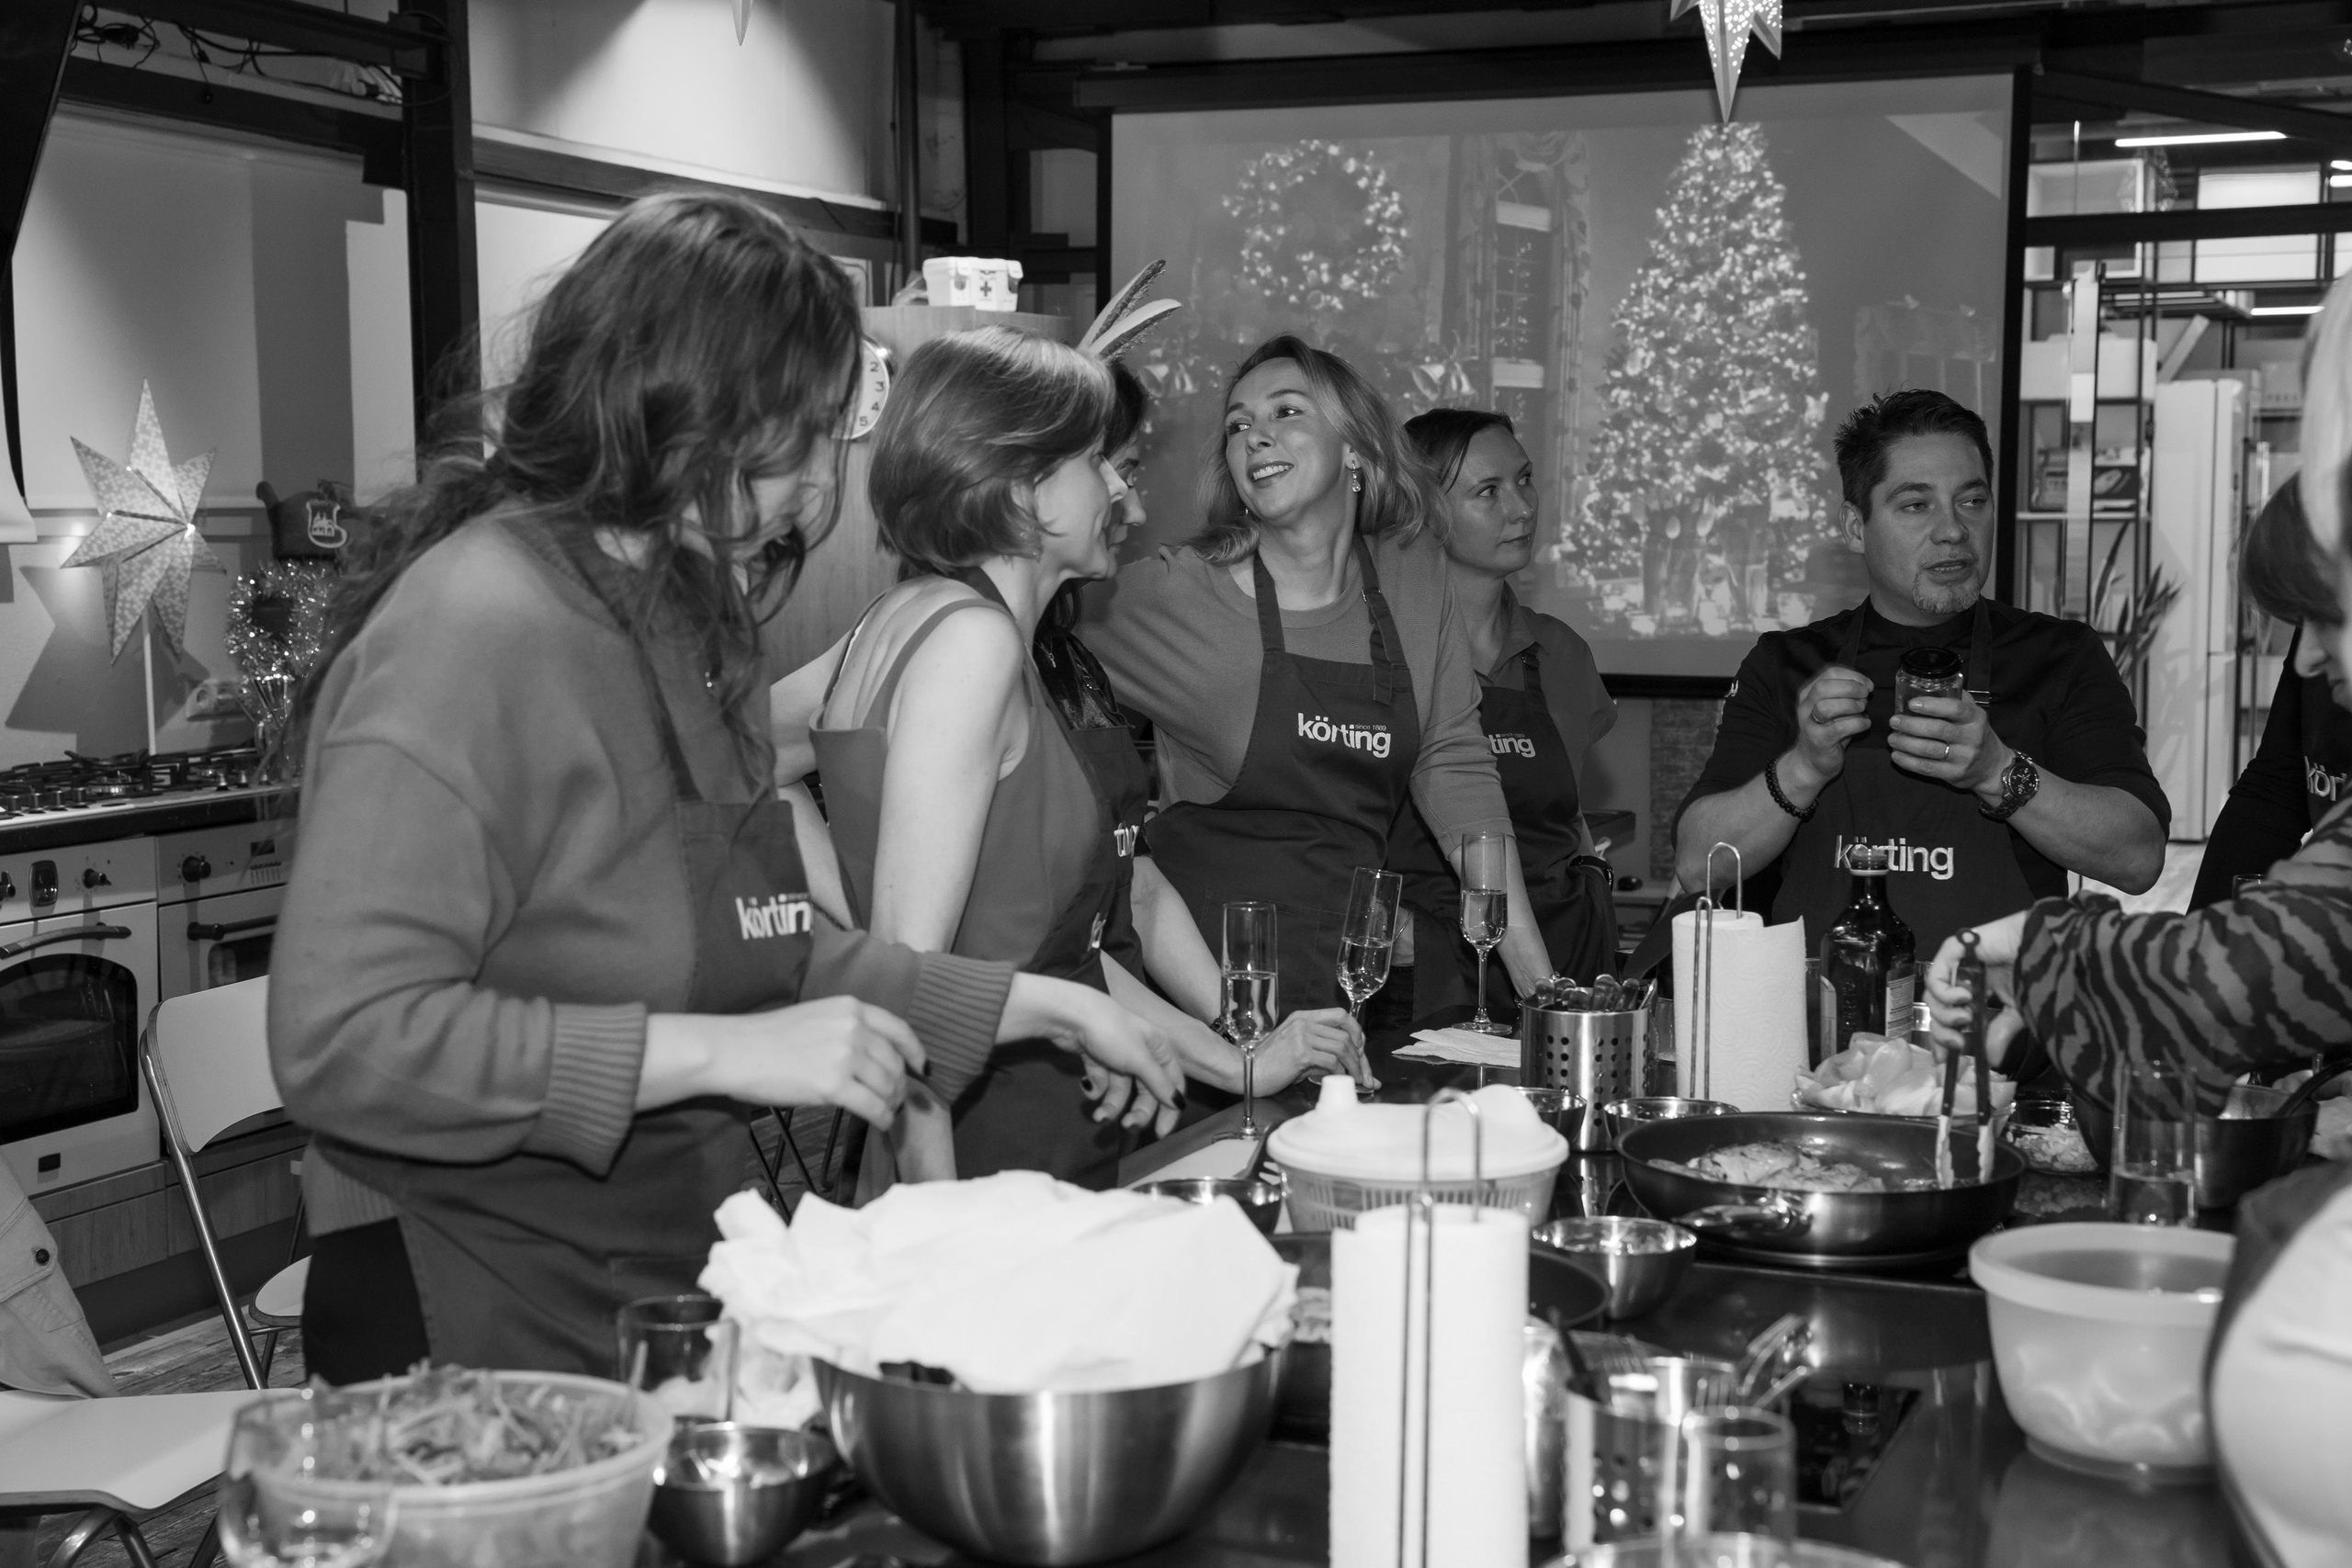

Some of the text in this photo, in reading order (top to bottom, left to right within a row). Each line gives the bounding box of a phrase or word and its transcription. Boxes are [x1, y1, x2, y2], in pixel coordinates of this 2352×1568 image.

[869, 361, 879, 373] 2
[875, 381, 885, 393] 3
[870, 401, 880, 412] 4
[859, 416, 869, 427] 5
[1297, 712, 1391, 759] körting
[1488, 733, 1536, 758] ting
[736, 893, 813, 941] körtin
